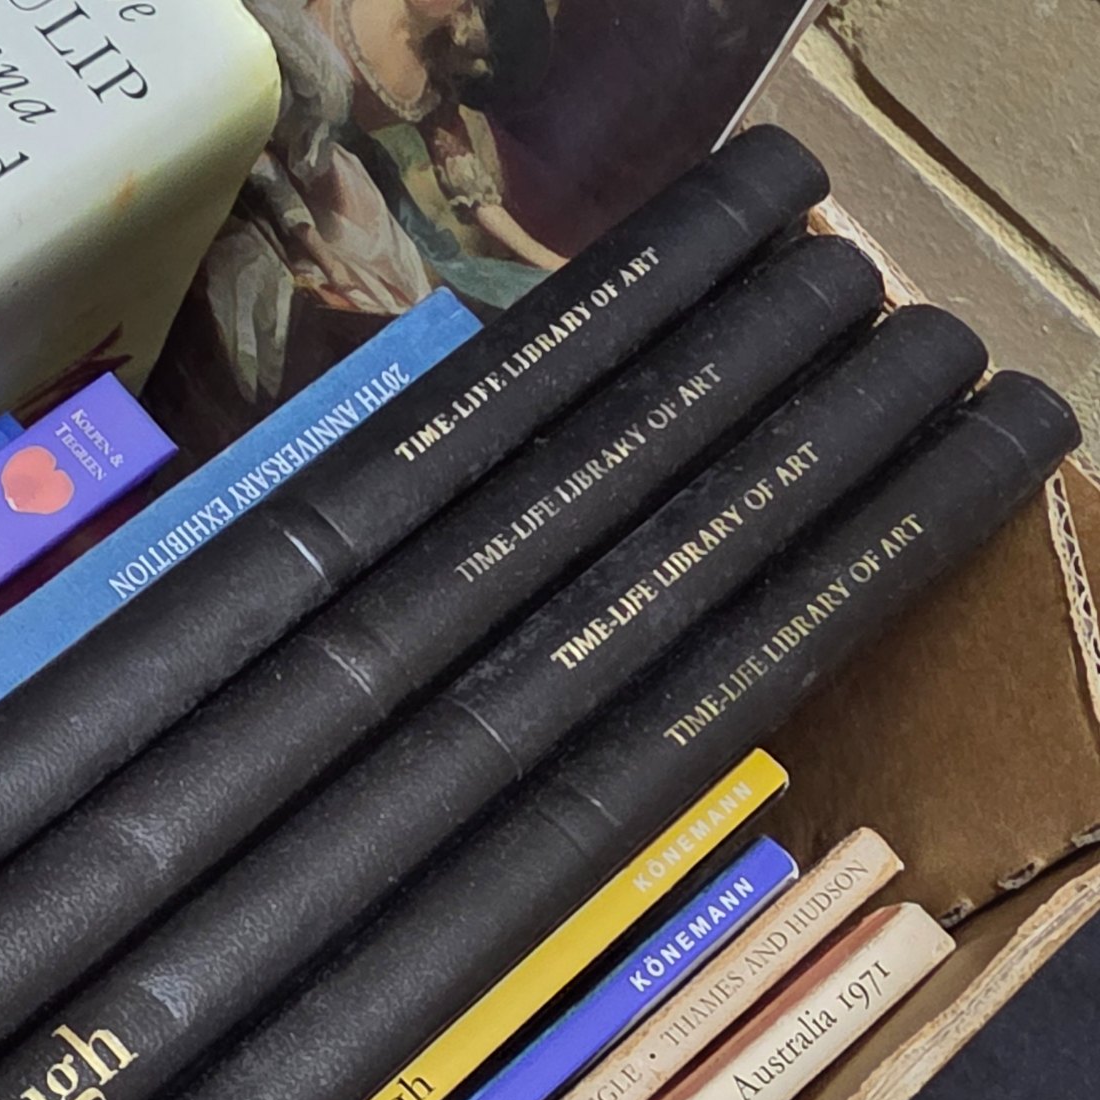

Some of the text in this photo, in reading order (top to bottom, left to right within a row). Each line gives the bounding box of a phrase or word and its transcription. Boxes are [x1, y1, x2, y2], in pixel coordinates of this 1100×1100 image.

[2, 0, 149, 103] LIP
[394, 246, 660, 462] TIME-LIFE LIBRARY OF ART
[108, 362, 410, 599] 20TH ANNIVERSARY EXHIBITION
[109, 453, 125, 468] &
[454, 363, 722, 583] TIME-LIFE LIBRARY OF ART
[550, 441, 819, 671] TIME-LIFE LIBRARY OF ART
[663, 513, 925, 747] TIME-LIFE LIBRARY OF ART
[629, 877, 755, 992] KÖNEMANN
[660, 859, 869, 1047] THAMES AND HUDSON
[835, 960, 891, 1013] 1971
